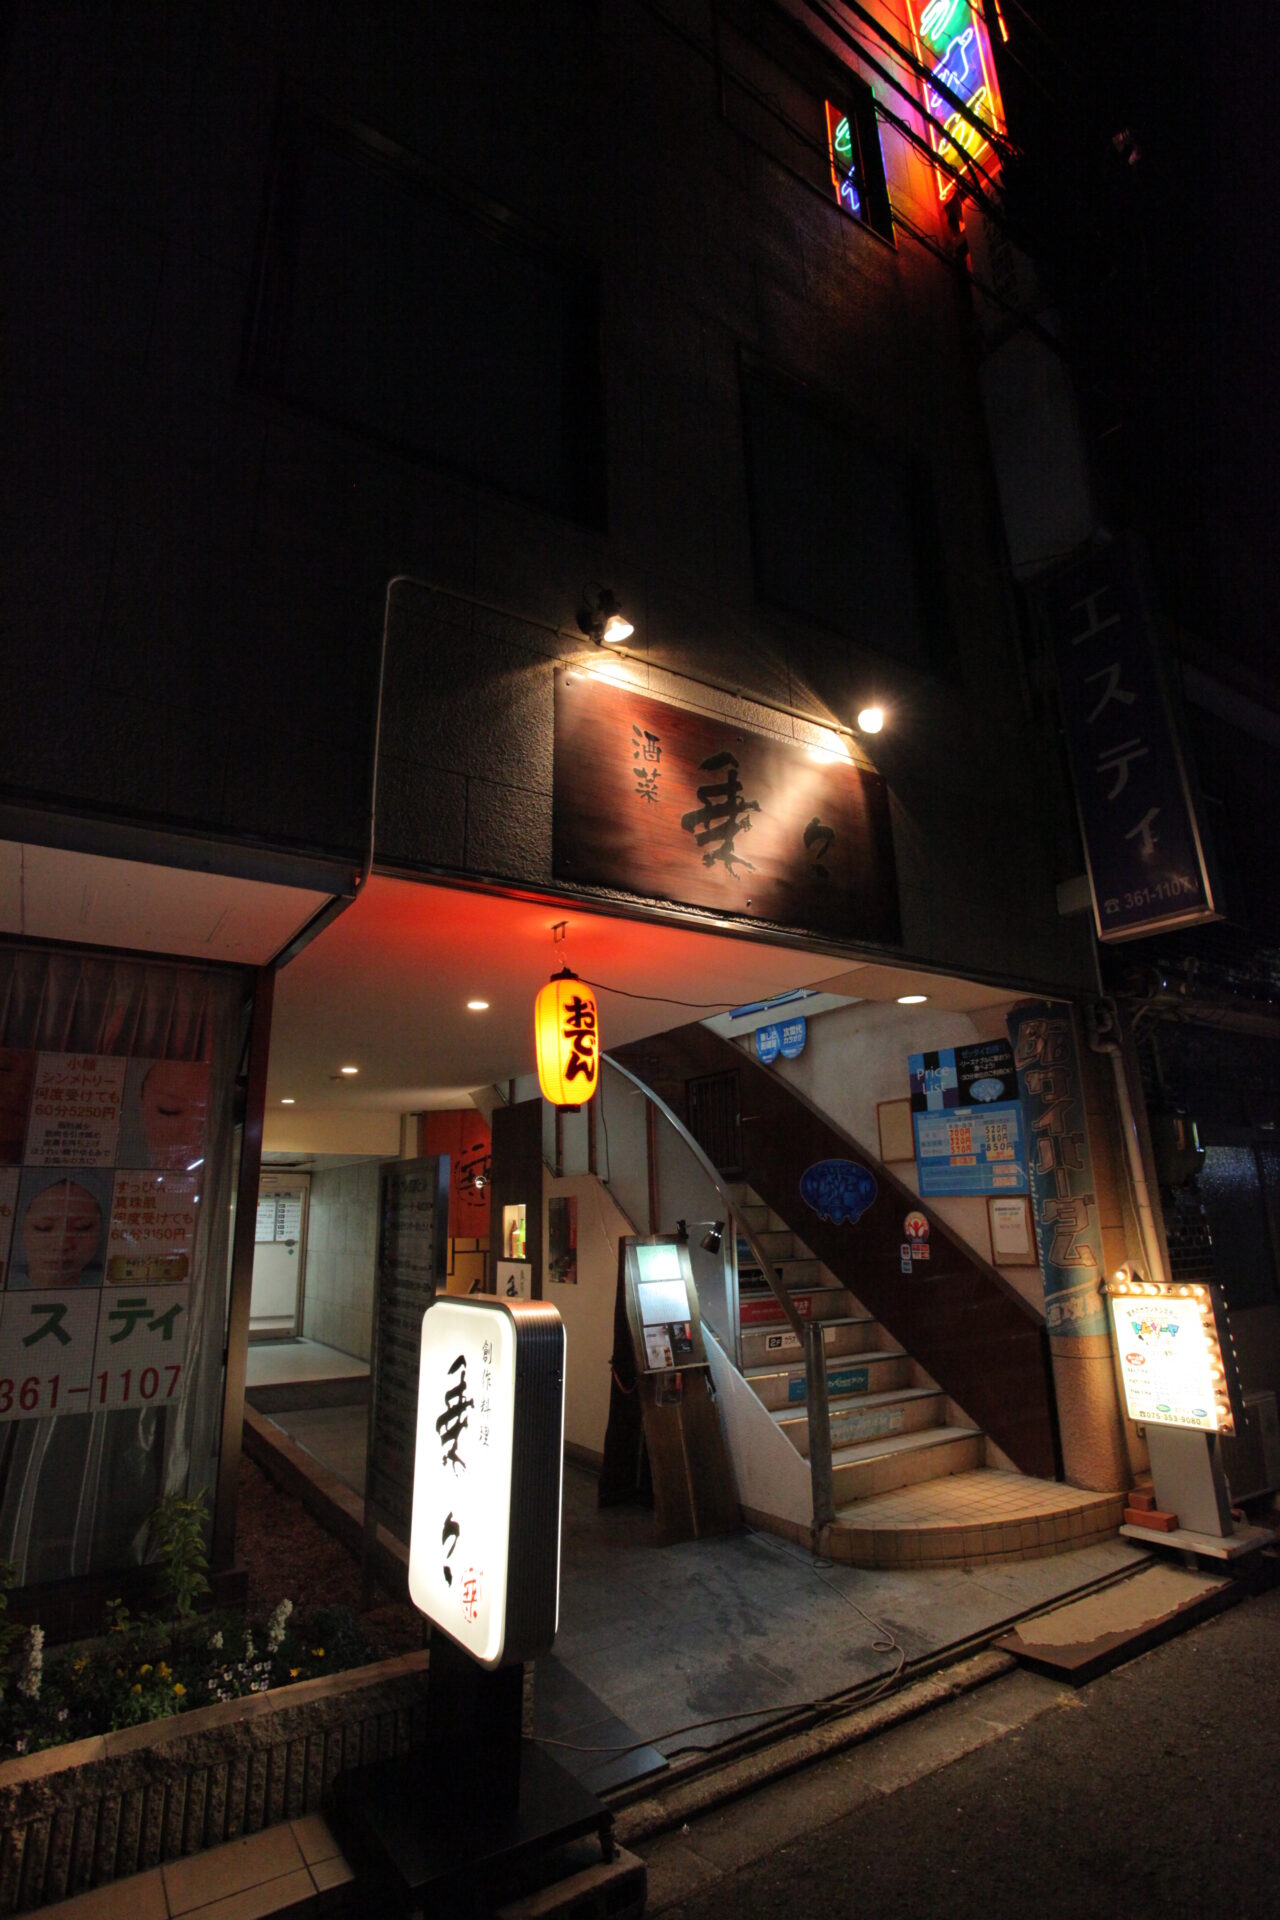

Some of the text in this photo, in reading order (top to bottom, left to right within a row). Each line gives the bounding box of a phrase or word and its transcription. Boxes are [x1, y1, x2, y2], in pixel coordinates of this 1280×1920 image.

[1070, 586, 1161, 857] エスティ
[631, 724, 662, 804] 酒菜
[563, 996, 597, 1083] おでん
[42, 1073, 116, 1087] シンメトリー
[917, 1066, 951, 1081] Price
[35, 1088, 121, 1104] 何度受けても
[921, 1081, 947, 1095] List
[35, 1104, 116, 1119] 60分5250円
[112, 1211, 194, 1227] 何度受けても
[0, 1365, 182, 1412] 361-1107
[478, 1341, 493, 1447] 創作料理
[1146, 1411, 1201, 1425] 075-353-9080
